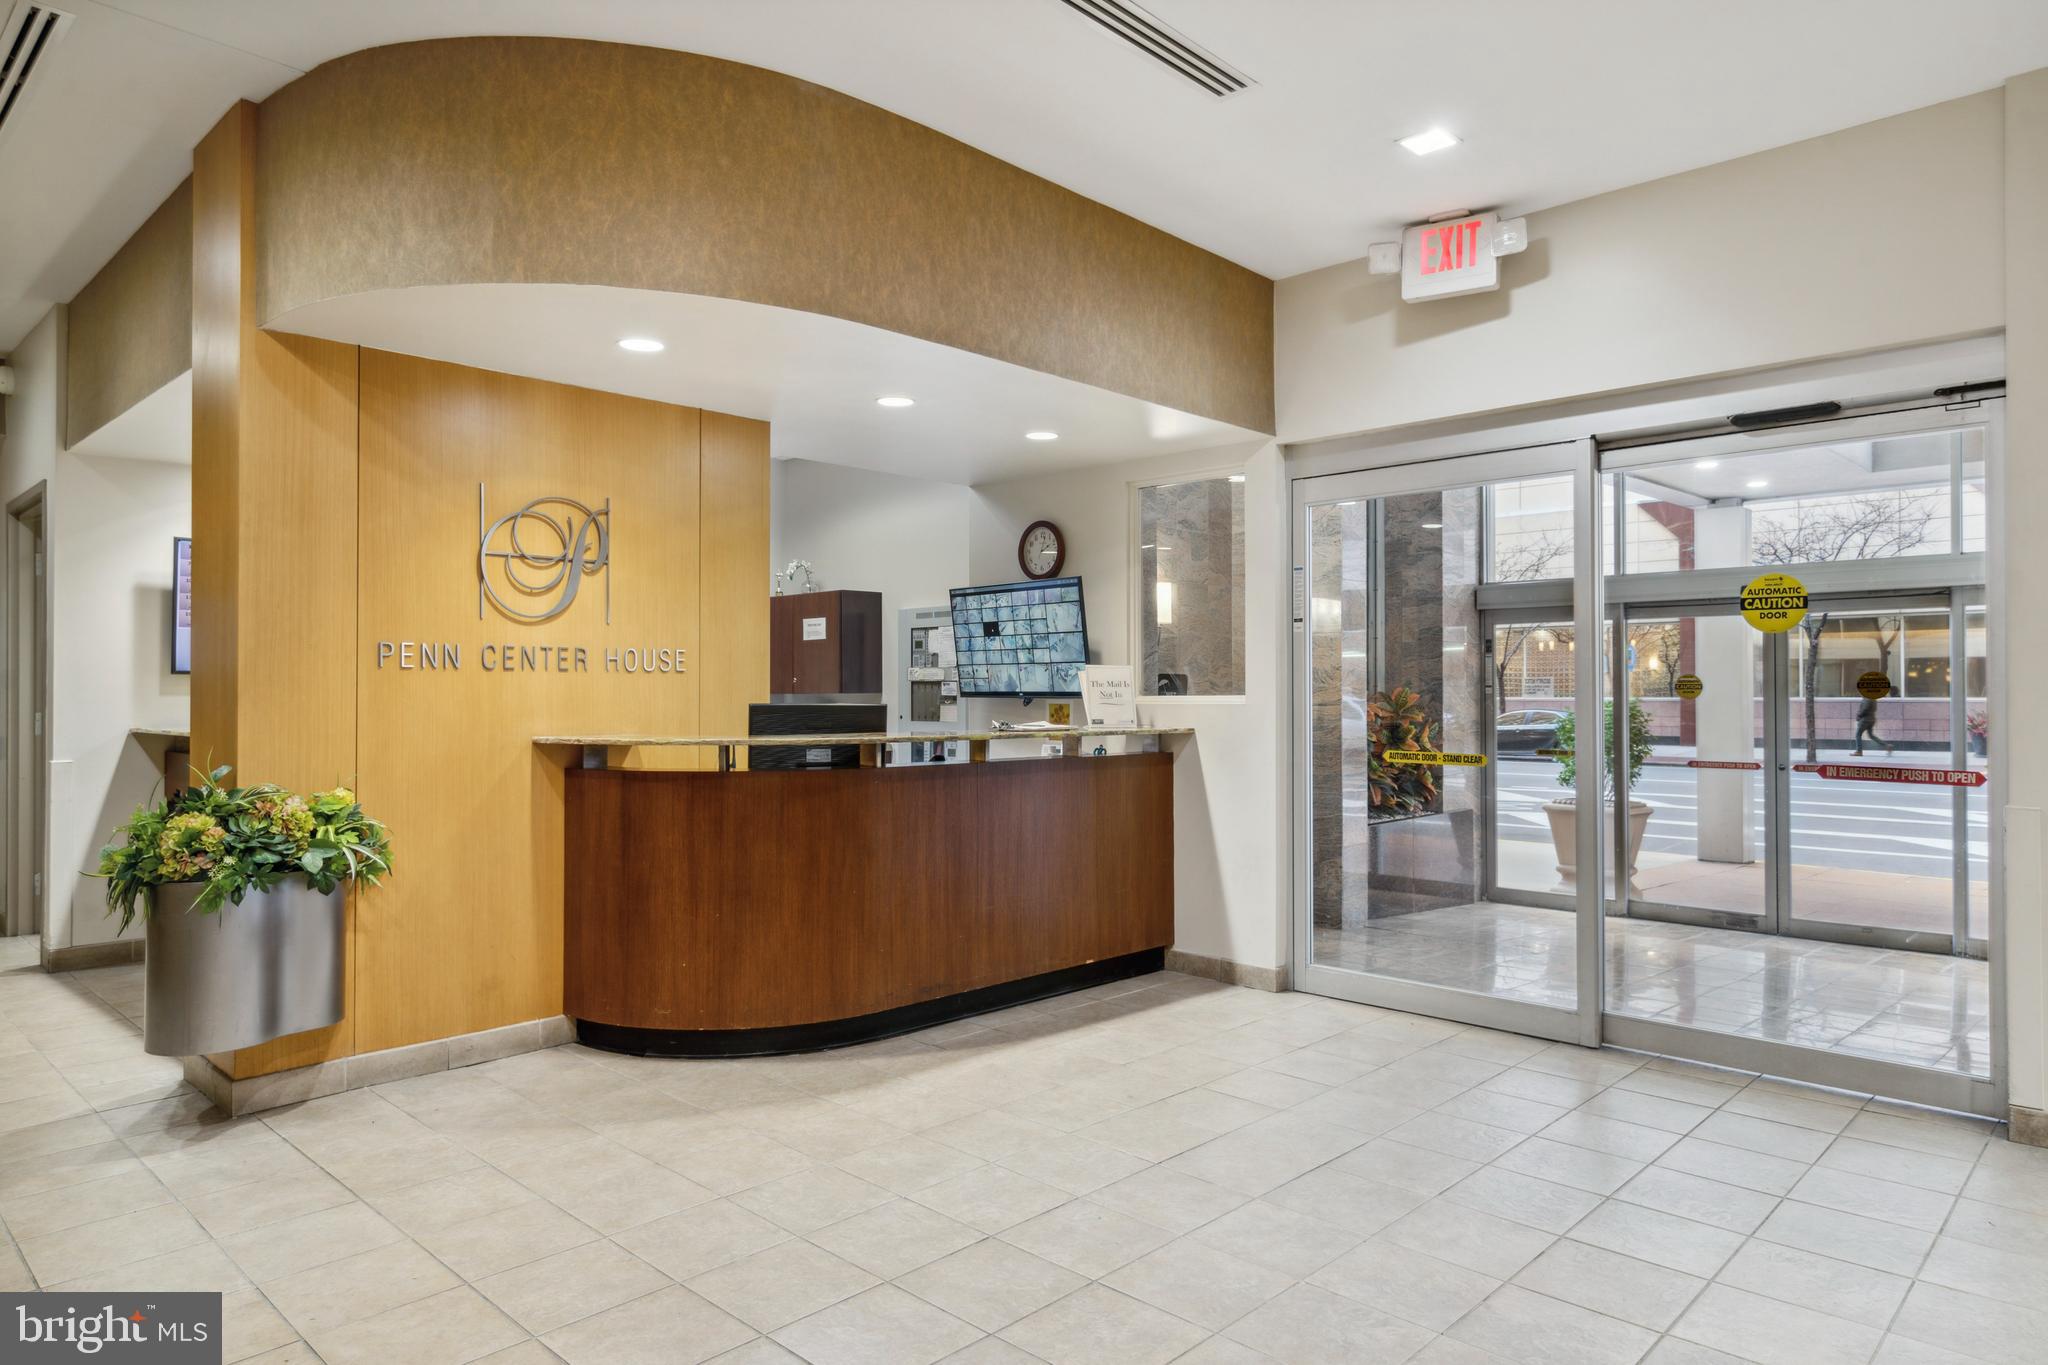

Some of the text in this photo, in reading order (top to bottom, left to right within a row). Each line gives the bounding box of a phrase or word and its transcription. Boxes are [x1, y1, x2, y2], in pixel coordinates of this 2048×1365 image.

[1419, 219, 1482, 276] EXIT
[1747, 586, 1802, 596] AUTOMATIC
[1744, 597, 1804, 609] CAUTION
[1759, 611, 1788, 619] DOOR
[377, 641, 687, 673] PENN CENTER HOUSE
[1090, 680, 1104, 688] The
[1106, 680, 1122, 688] Mail
[1388, 751, 1421, 761] AUTOMATIC
[1421, 752, 1438, 762] DOOR
[1442, 754, 1462, 763] STAND
[1463, 755, 1483, 764] CLEAR
[1826, 766, 1837, 777] IN
[1839, 767, 1900, 780] EMERGENCY
[1901, 770, 1929, 781] PUSH
[1932, 772, 1944, 783] TO
[1947, 773, 1977, 784] OPEN
